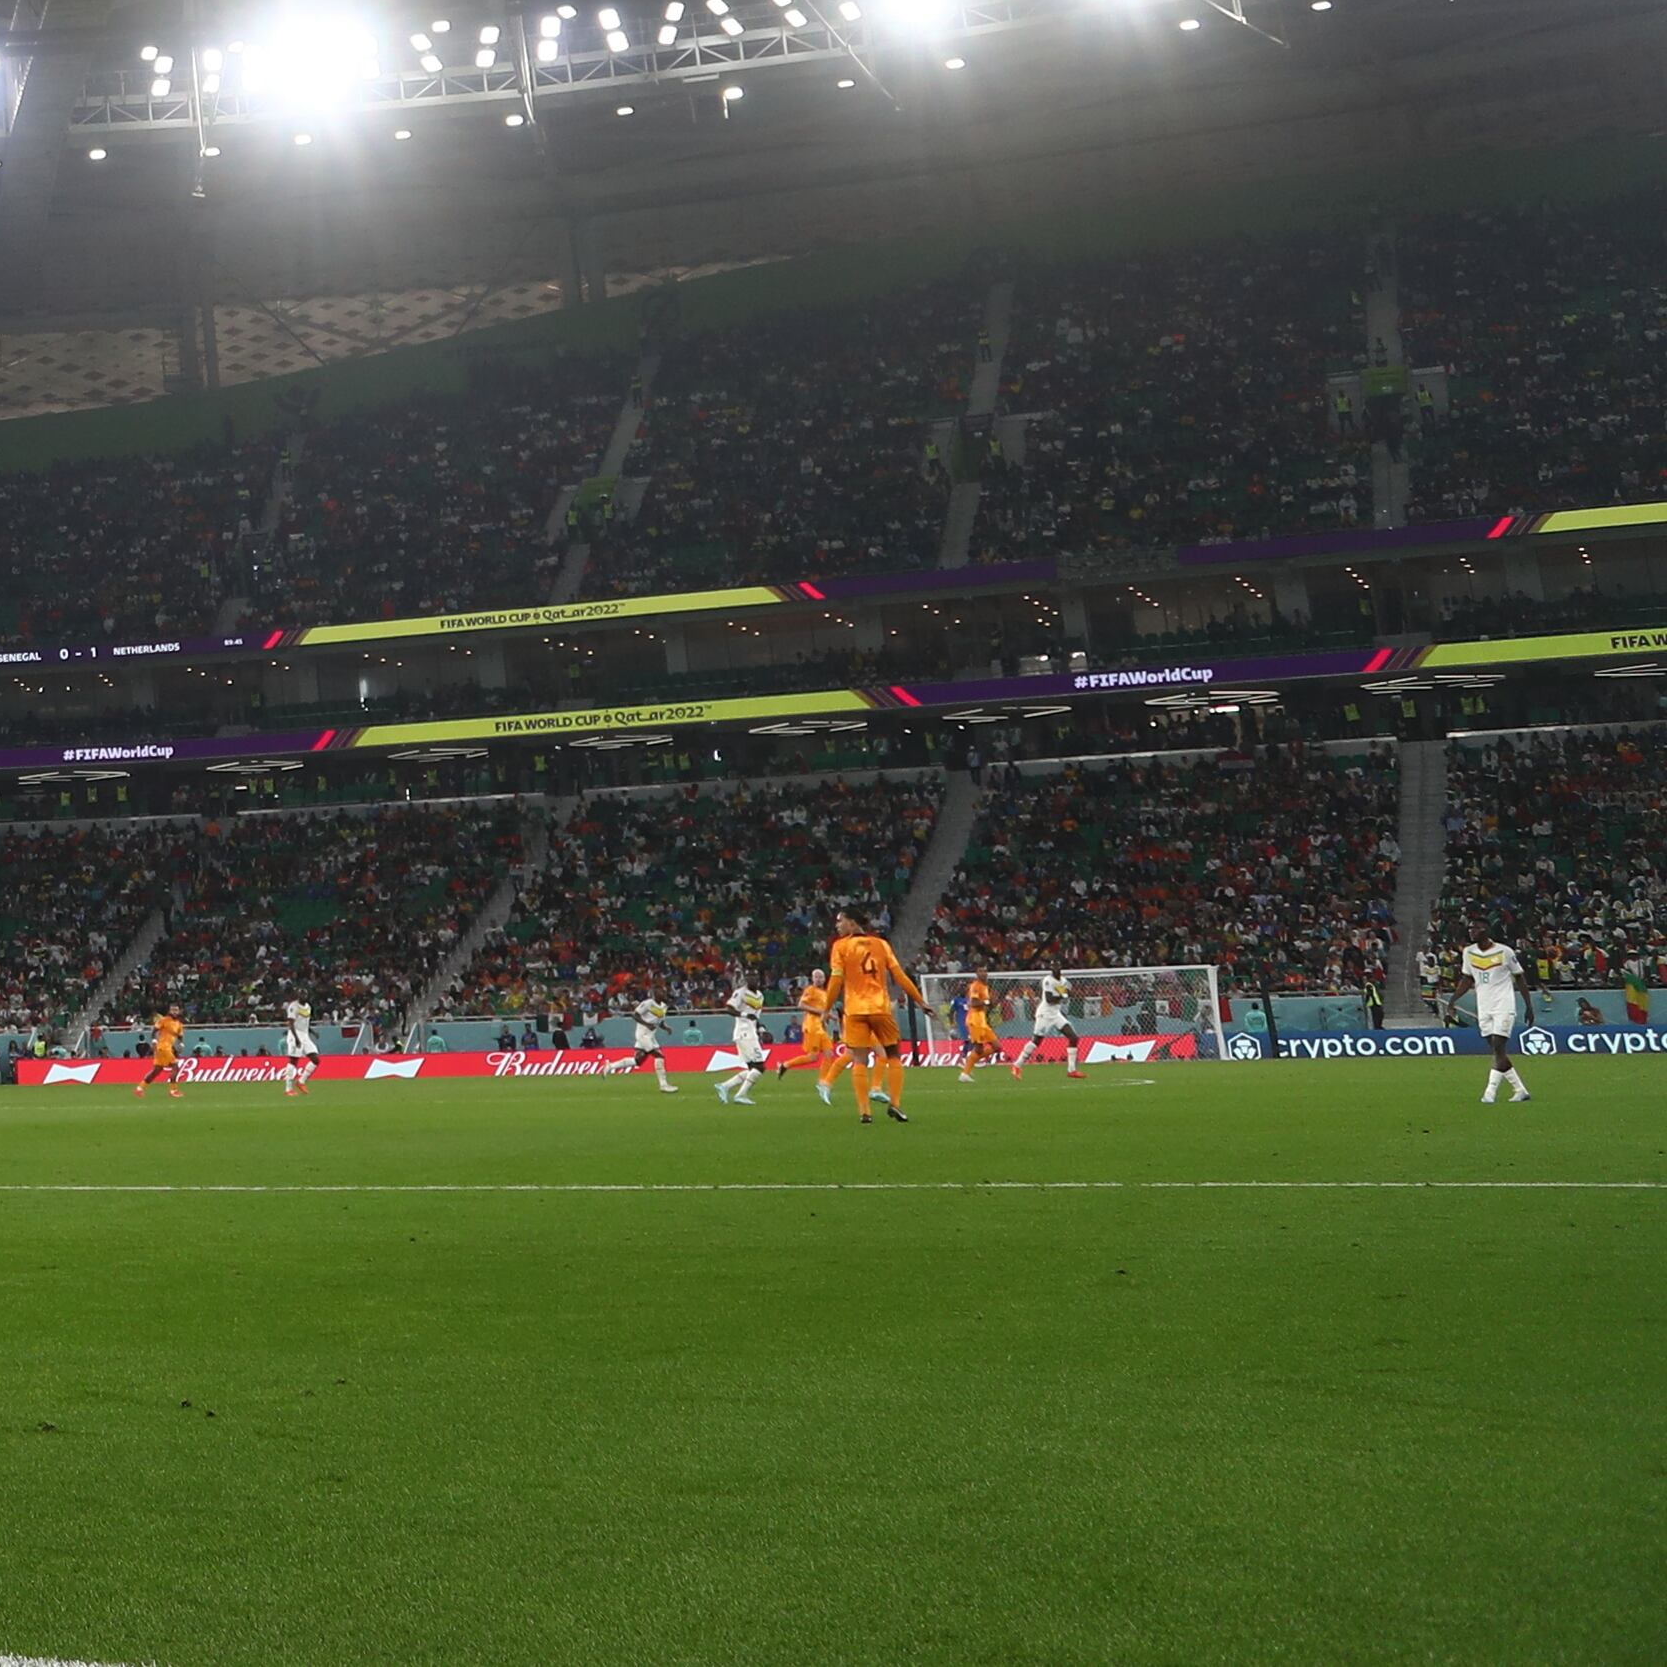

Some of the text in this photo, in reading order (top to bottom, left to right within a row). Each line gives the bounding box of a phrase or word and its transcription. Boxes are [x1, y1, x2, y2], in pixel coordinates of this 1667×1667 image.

[440, 619, 465, 629] FIFA
[466, 615, 508, 627] WORLD
[509, 612, 531, 623] CUP
[59, 648, 69, 660] 0
[90, 647, 97, 658] 1
[112, 642, 181, 656] NETHERLANDS
[1610, 635, 1651, 649] FIFA
[1074, 667, 1213, 688] #FIFAWorldCup
[495, 720, 523, 733] FIFA
[524, 717, 573, 730] WORLD
[574, 714, 601, 726] CUP
[63, 744, 174, 761] #FIFAWorldCup
[861, 952, 877, 980] 4
